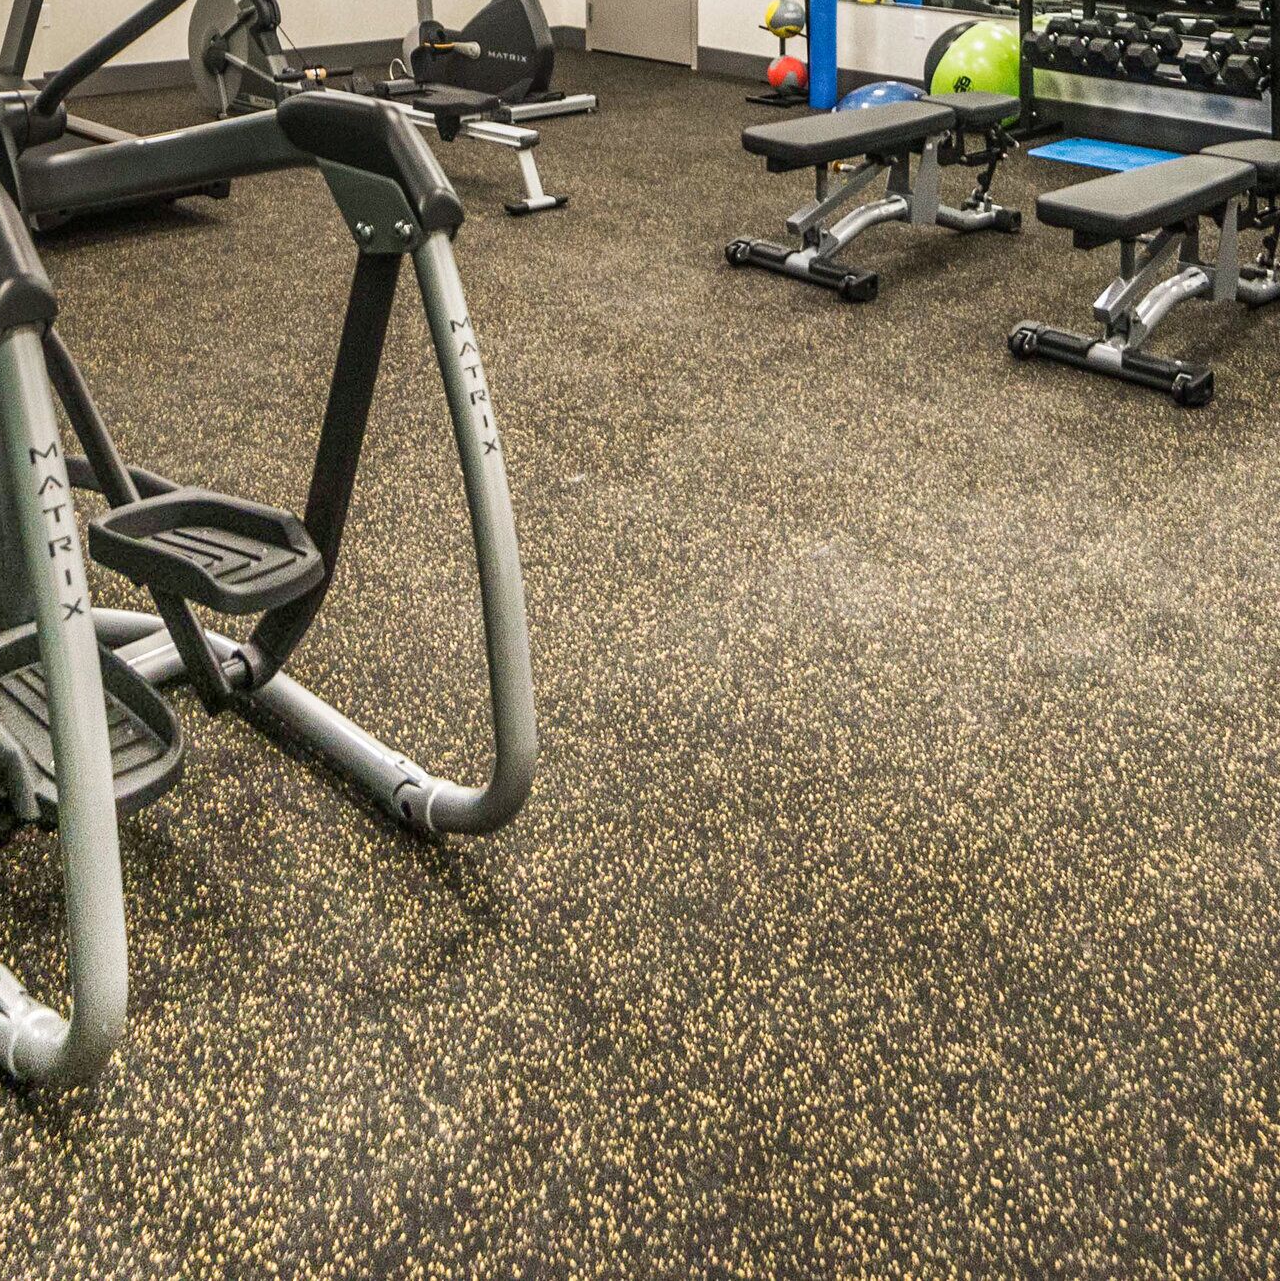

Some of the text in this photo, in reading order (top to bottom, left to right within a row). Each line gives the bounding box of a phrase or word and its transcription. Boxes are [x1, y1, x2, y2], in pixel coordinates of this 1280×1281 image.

[487, 50, 527, 63] MATRIX
[450, 316, 499, 456] MATRIX
[29, 440, 86, 624] MATRIX
